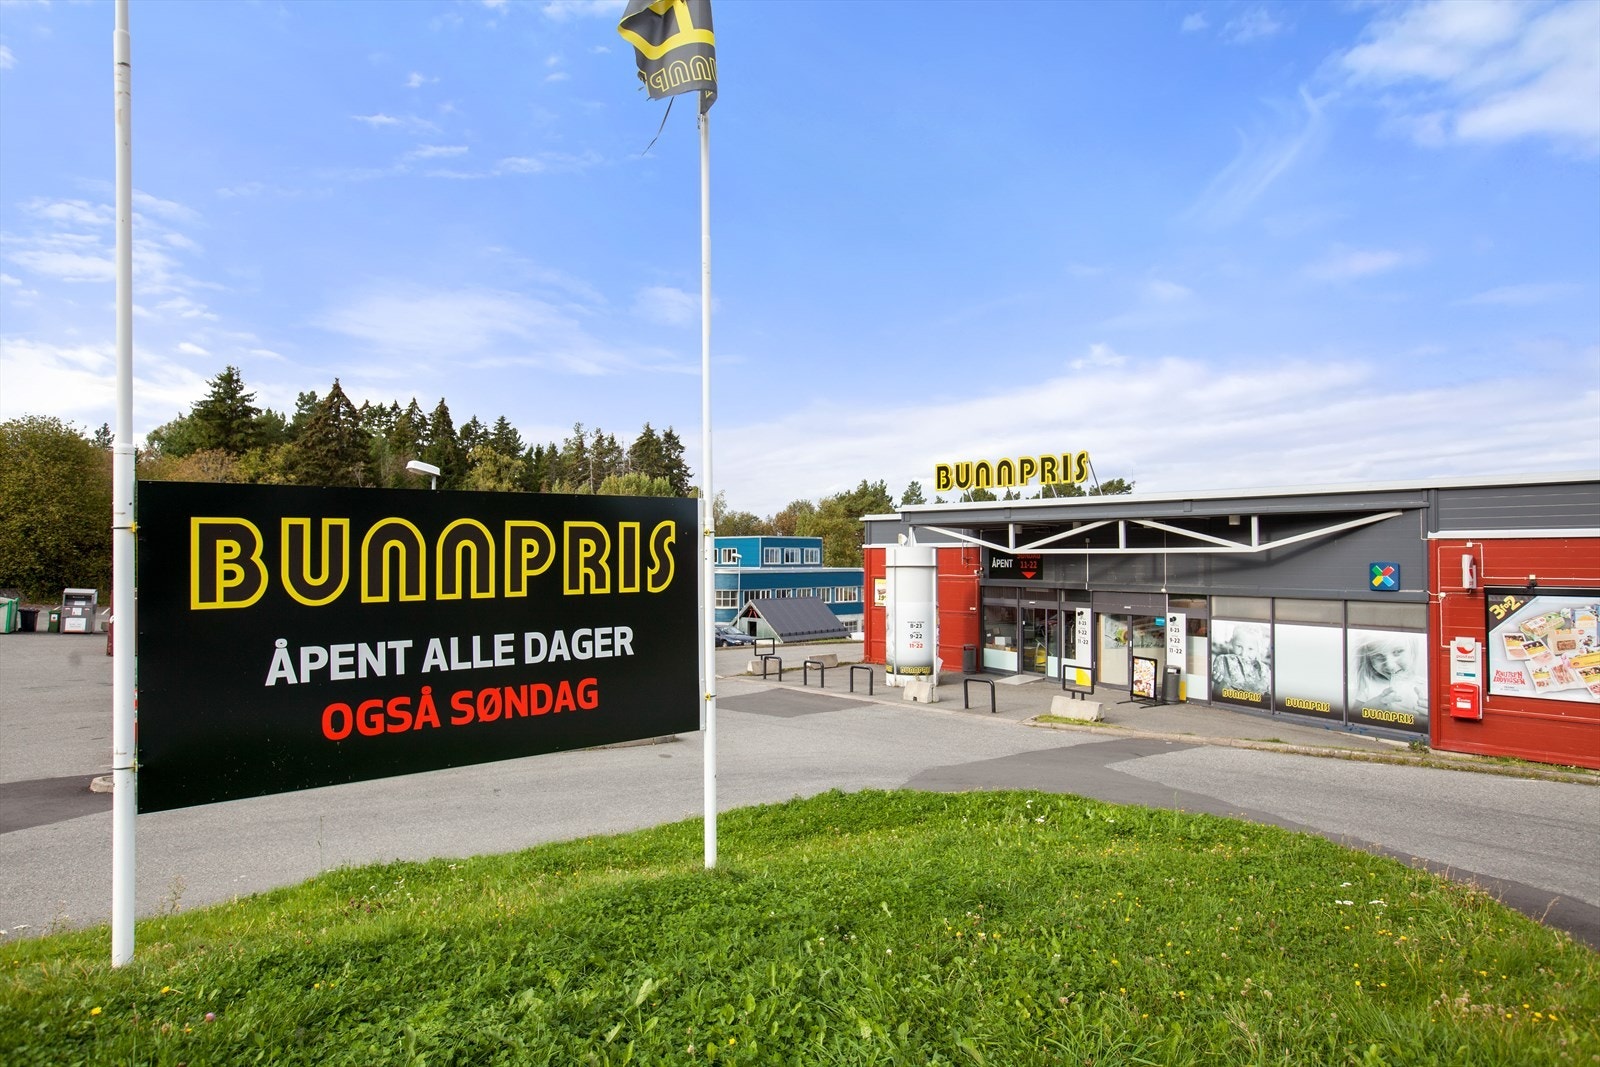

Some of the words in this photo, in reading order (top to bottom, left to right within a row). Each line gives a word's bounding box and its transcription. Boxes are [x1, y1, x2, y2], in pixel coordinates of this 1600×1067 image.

[935, 450, 1088, 491] BUNNPRIS
[190, 516, 676, 610] BUNNPRIS
[991, 557, 1013, 568] ÅPENT
[265, 638, 412, 687] ÅPENT
[421, 634, 515, 673] ALLE
[524, 626, 635, 664] DAGER
[321, 686, 441, 742] OGSÅ
[450, 677, 598, 726] SØNDAG
[1222, 688, 1262, 702] BUNNPRIS
[1285, 697, 1330, 713] BUNNPRIS
[1362, 708, 1414, 725] BUNNPRIS
